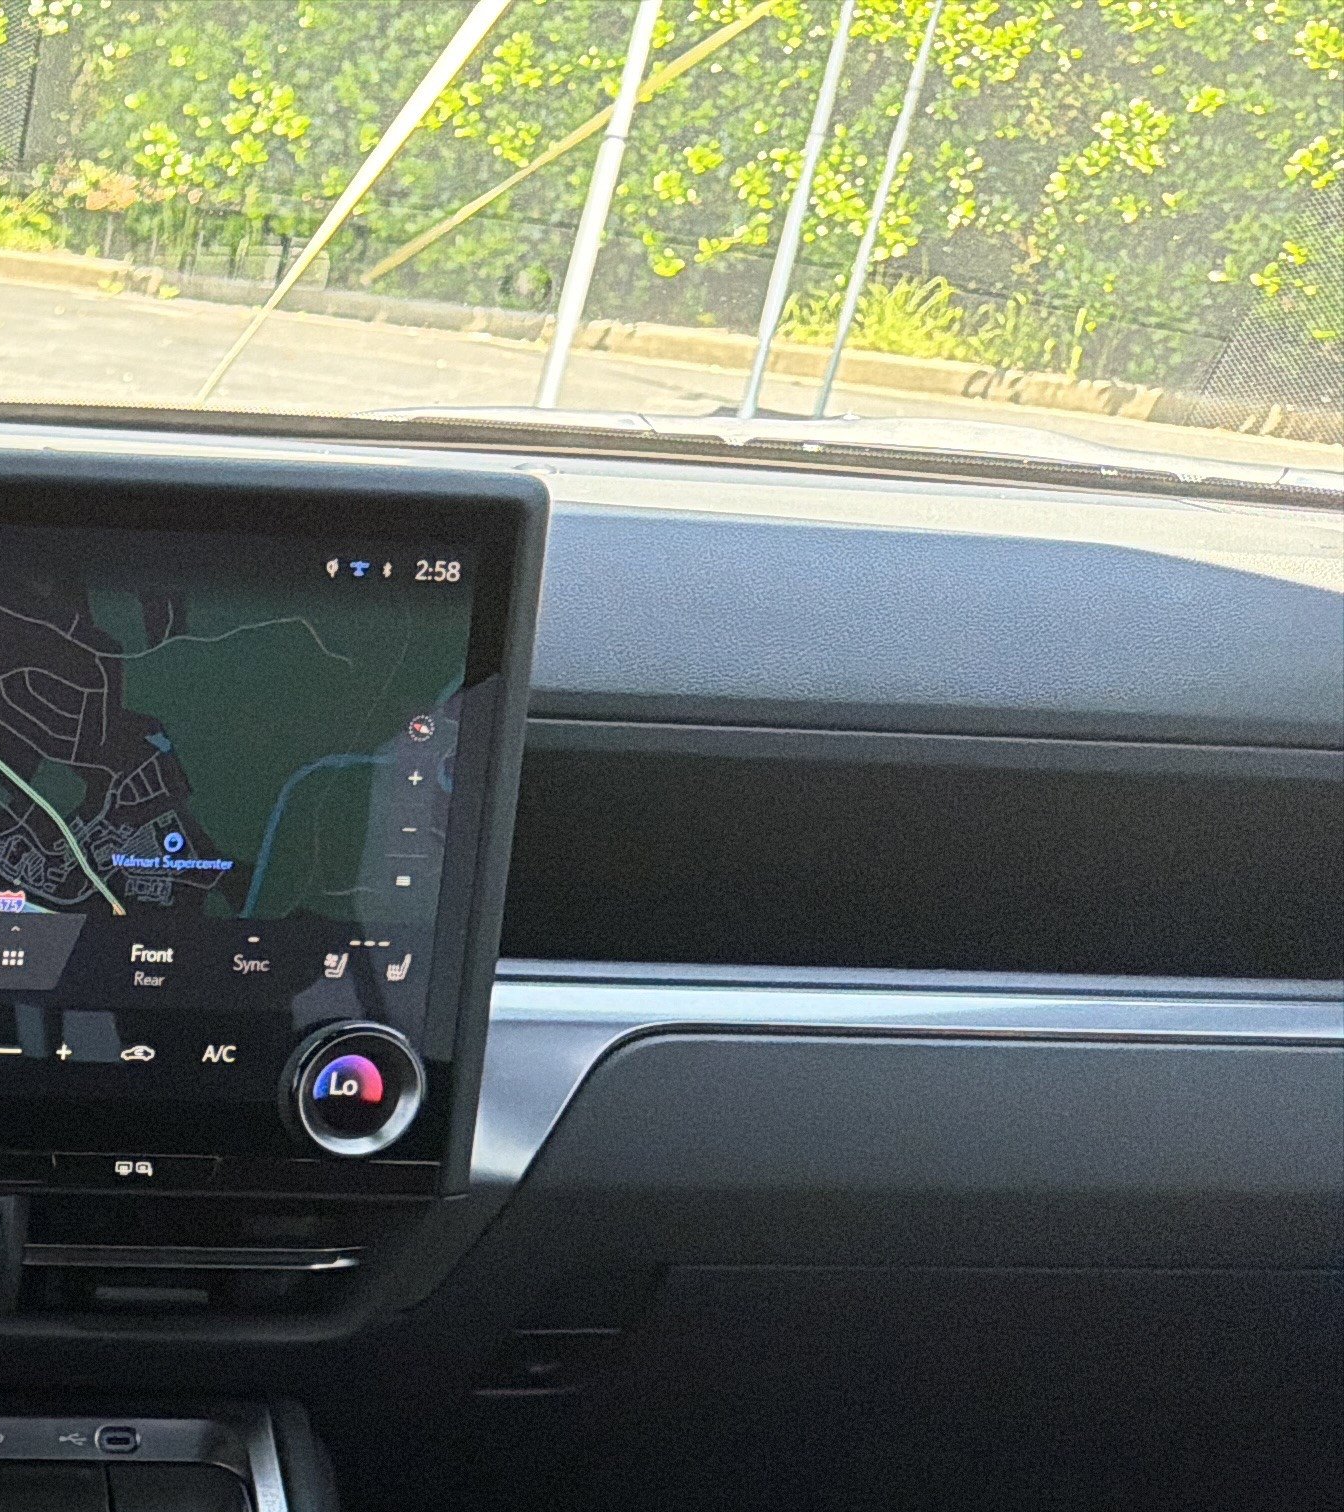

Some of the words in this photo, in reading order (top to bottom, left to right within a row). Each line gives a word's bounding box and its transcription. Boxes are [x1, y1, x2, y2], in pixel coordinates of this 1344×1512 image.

[414, 560, 461, 583] 2:58
[112, 853, 160, 868] Walmart
[162, 855, 234, 870] Supercenter
[130, 944, 174, 963] Front
[232, 953, 271, 974] Sync
[133, 971, 166, 988] Rear
[202, 1044, 237, 1064] A/C
[330, 1072, 359, 1097] Lo
